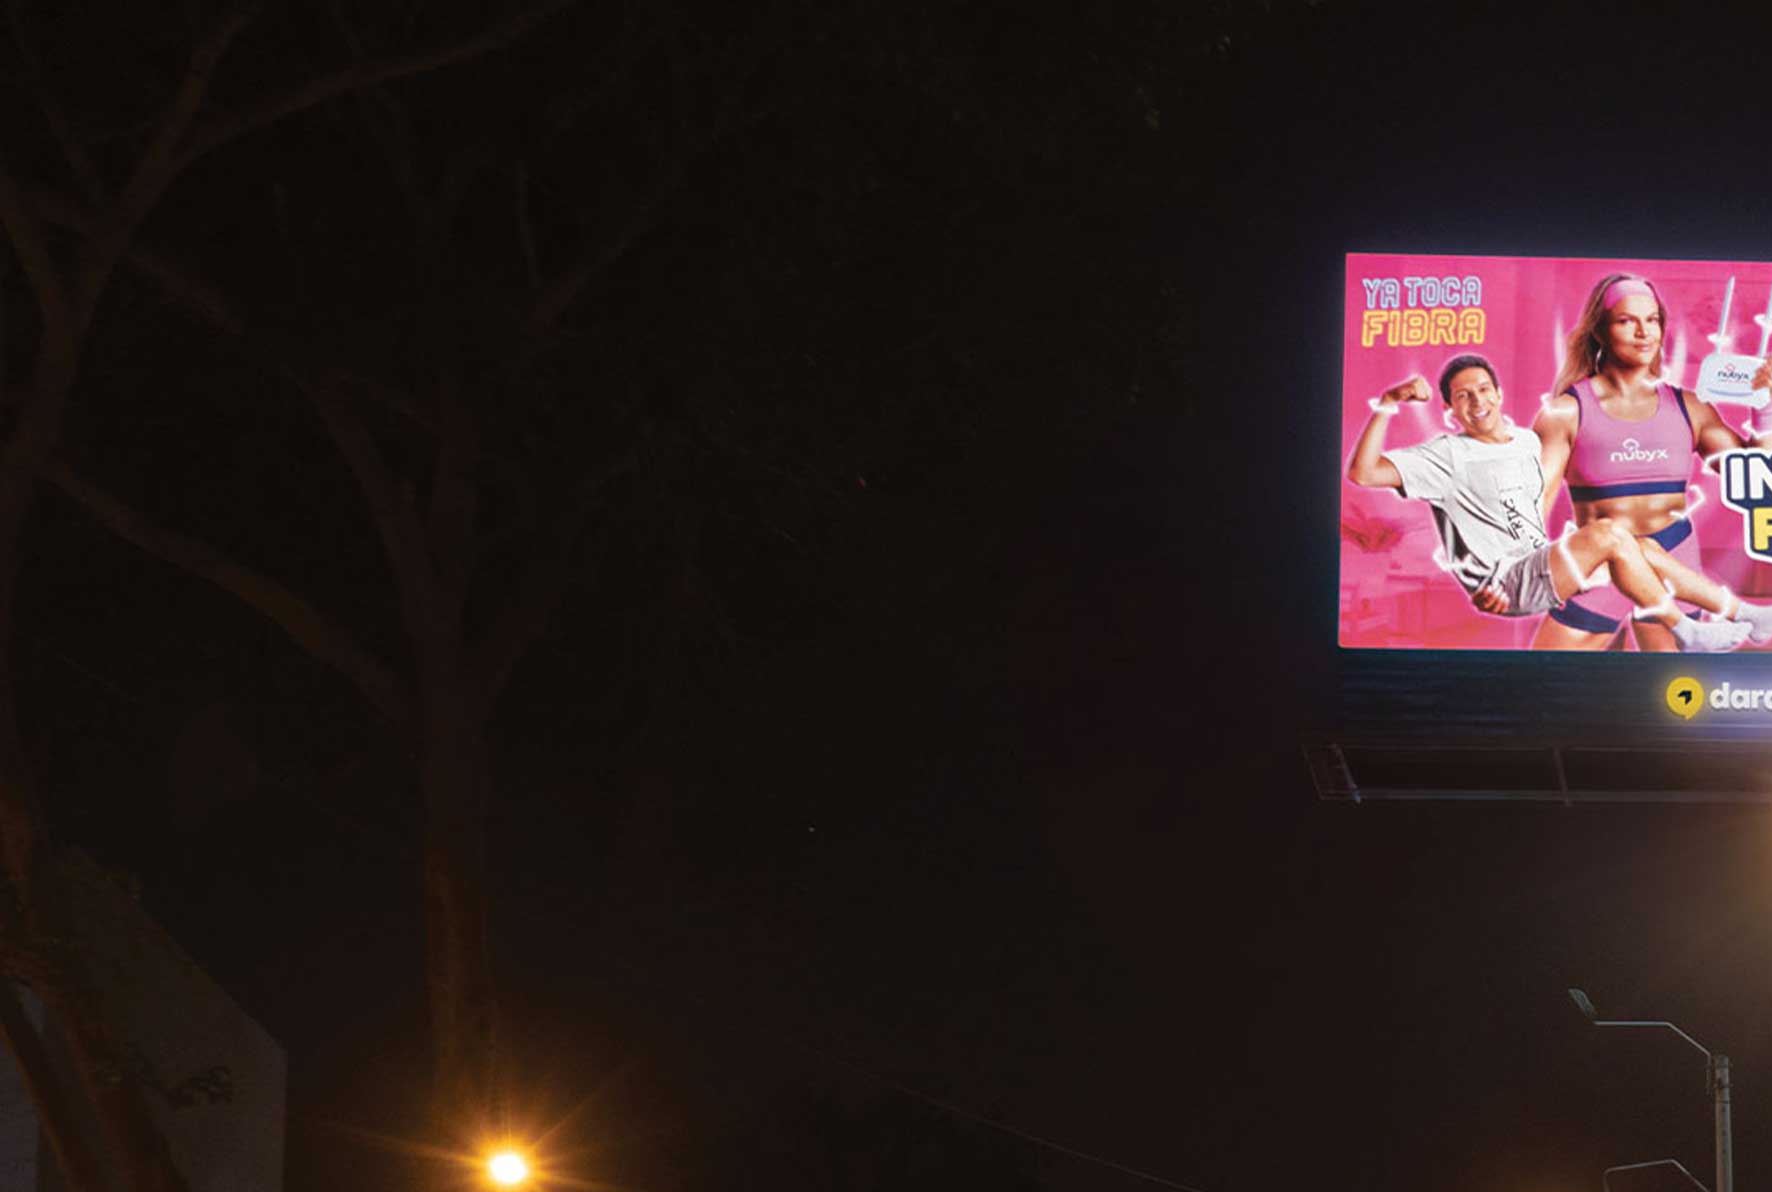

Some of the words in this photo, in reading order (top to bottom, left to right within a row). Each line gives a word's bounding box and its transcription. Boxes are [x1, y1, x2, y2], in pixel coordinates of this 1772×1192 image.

[1362, 278, 1400, 309] YA
[1403, 276, 1482, 307] TOCA
[1361, 308, 1487, 347] FIBRA
[1610, 447, 1669, 462] nubyx
